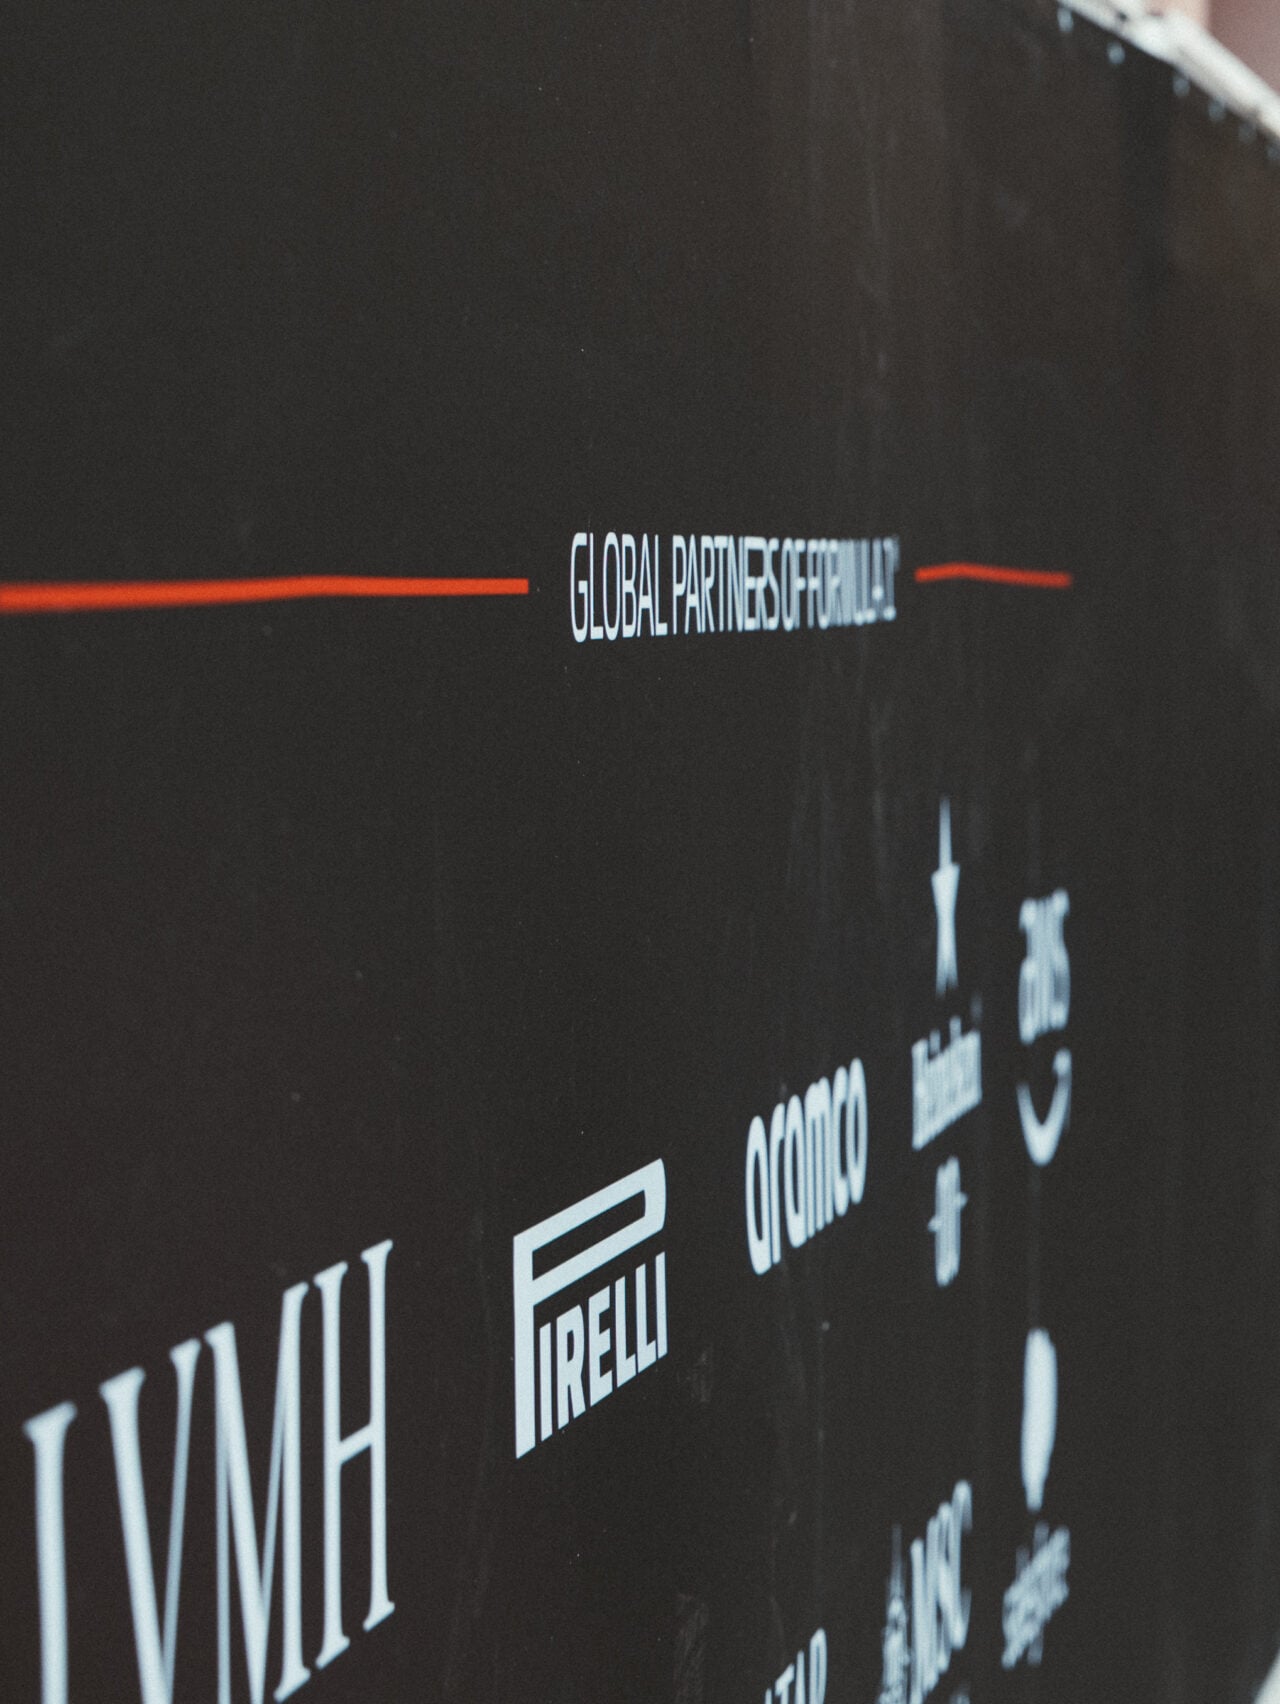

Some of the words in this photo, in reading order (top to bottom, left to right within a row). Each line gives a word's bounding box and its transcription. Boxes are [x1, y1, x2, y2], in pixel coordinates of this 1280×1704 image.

[570, 532, 668, 643] GLOBAL
[672, 534, 779, 634] PARTNERS
[781, 537, 806, 633] OF
[746, 1057, 868, 1276] aramco
[513, 1158, 668, 1460] PIRELLI
